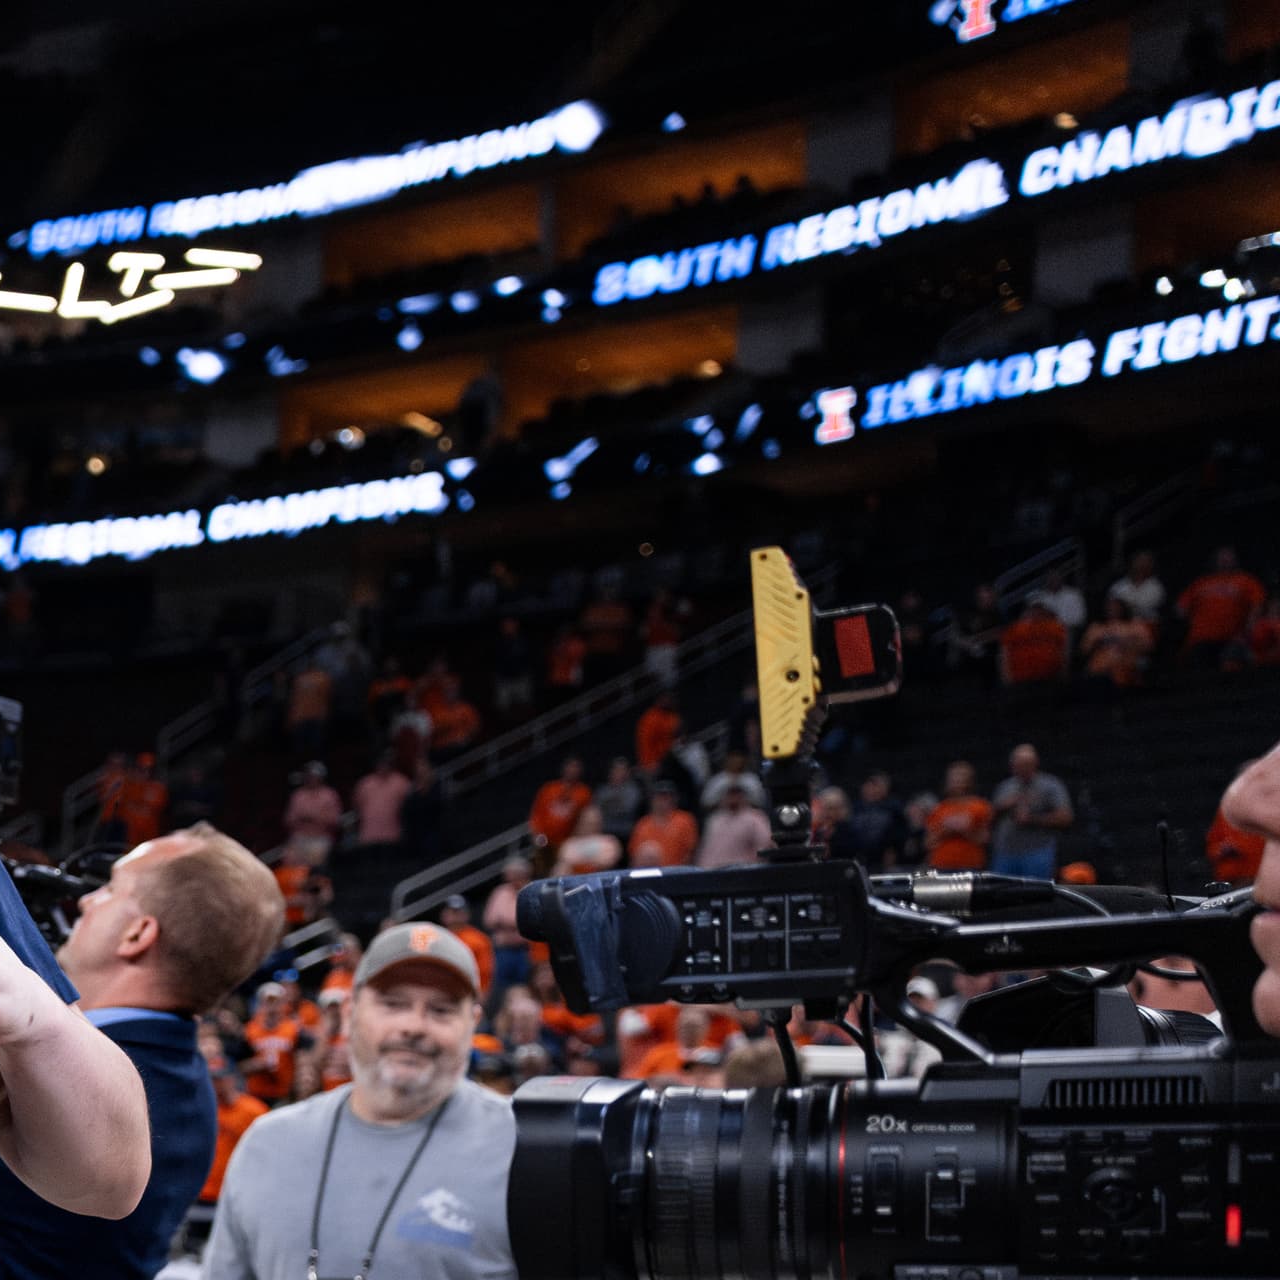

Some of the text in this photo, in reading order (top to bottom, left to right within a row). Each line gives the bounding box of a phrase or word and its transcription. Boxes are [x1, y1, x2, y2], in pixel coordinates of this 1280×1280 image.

[592, 235, 758, 306] SOUTH
[761, 158, 1010, 271] REGIONAL
[860, 337, 1096, 430] ILLINOIS
[866, 1115, 908, 1134] 20x
